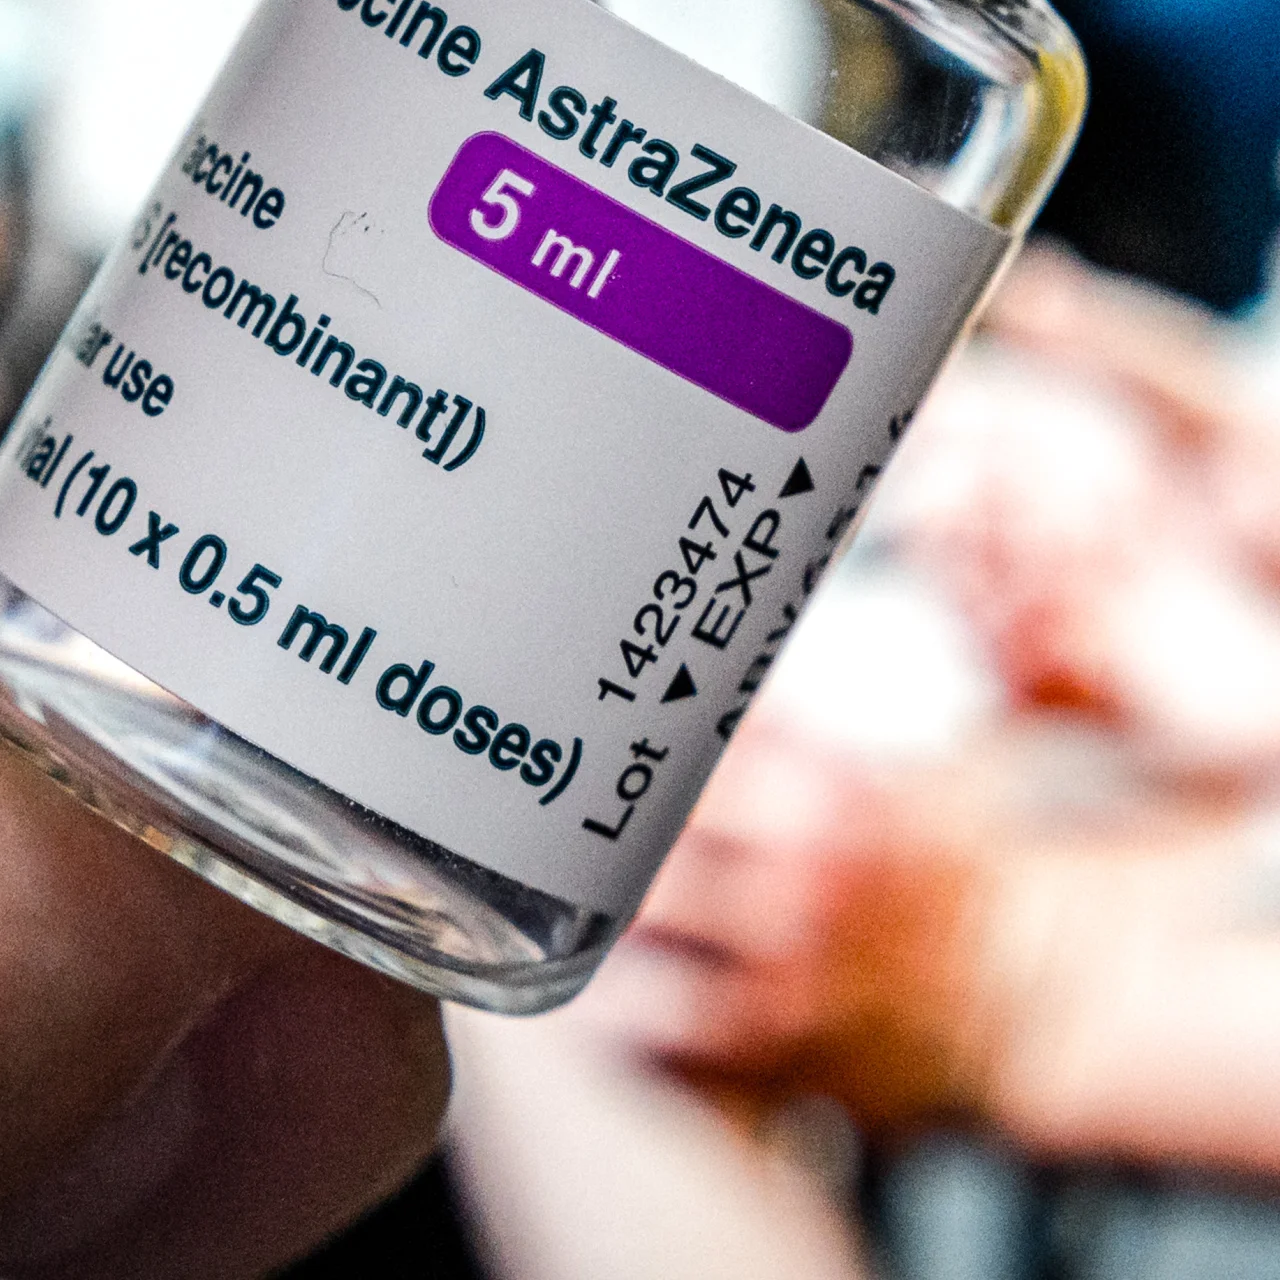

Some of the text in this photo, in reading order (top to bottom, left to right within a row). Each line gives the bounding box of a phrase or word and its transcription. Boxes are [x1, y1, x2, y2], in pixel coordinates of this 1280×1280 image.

[179, 133, 285, 230] accine
[470, 169, 621, 298] 5 ml
[484, 48, 897, 316] AstraZeneca
[103, 343, 174, 417] use
[138, 211, 486, 472] [recombinant])
[54, 451, 137, 536] (10
[128, 510, 180, 570] x
[179, 534, 282, 626] 0.5
[277, 604, 377, 685] ml
[375, 659, 584, 807] doses)
[582, 508, 782, 844] Lot EXP
[597, 467, 756, 703] 1423474
